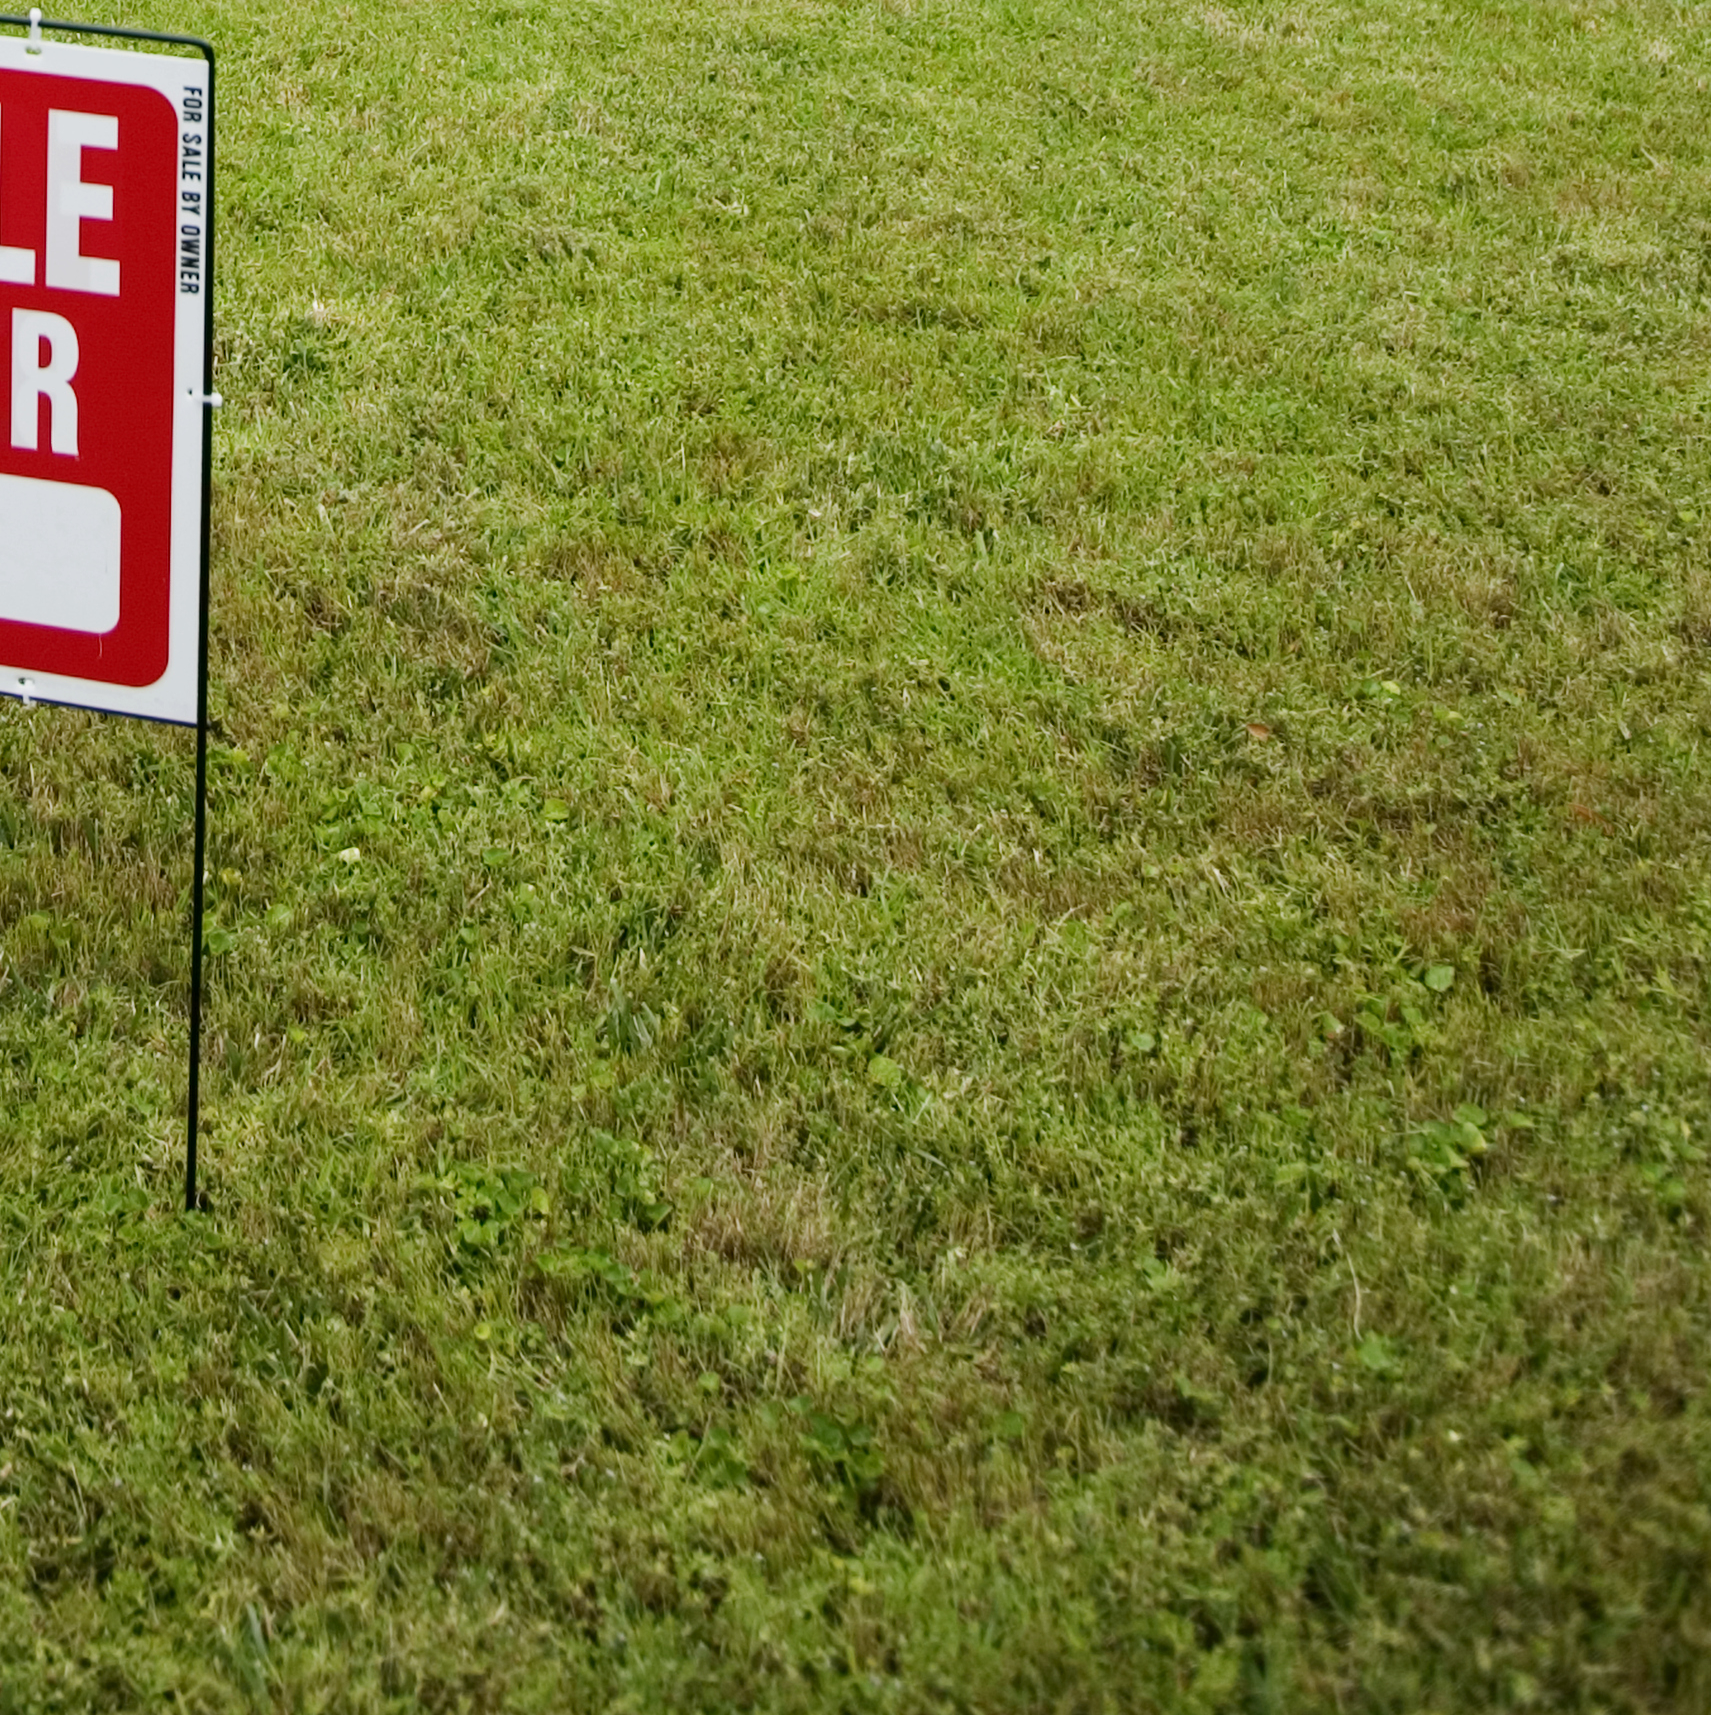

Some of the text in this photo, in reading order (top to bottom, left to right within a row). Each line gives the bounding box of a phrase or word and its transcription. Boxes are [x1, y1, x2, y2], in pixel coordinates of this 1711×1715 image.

[180, 85, 203, 294] FOR SALE BY OWNER
